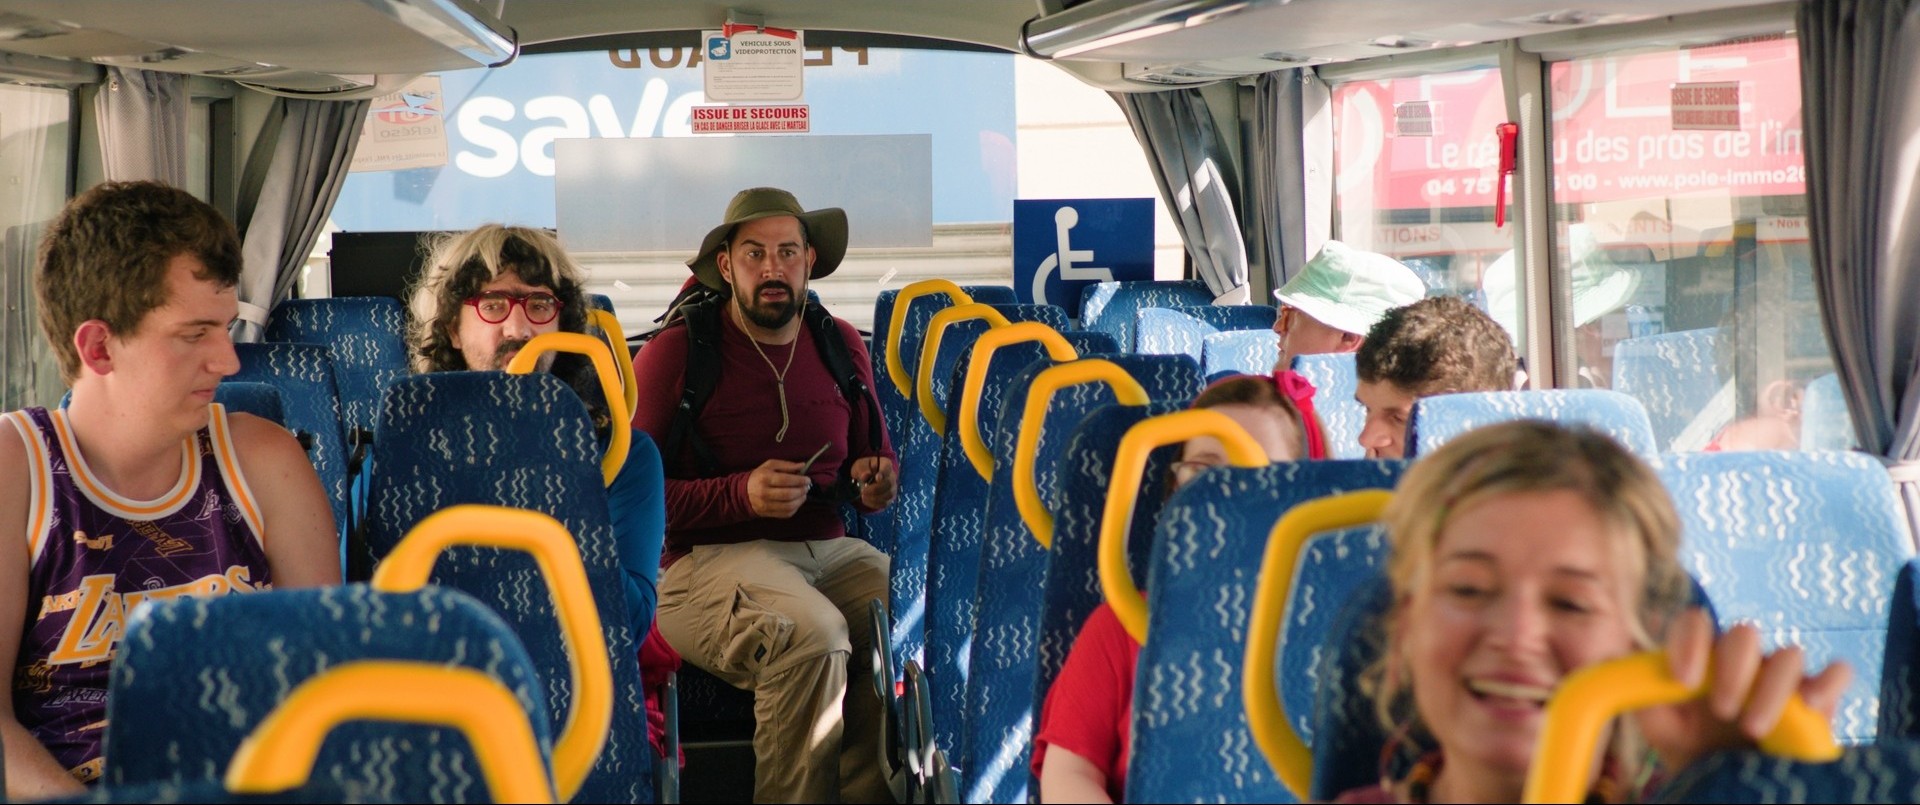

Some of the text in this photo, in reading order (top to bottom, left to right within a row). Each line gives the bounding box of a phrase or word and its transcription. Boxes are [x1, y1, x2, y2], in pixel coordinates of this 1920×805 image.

[694, 108, 807, 119] ISSUE DE SECOURS
[716, 122, 733, 130] DANGER
[749, 122, 755, 130] LA
[756, 121, 769, 130] GLACE
[787, 121, 807, 130] MARTEAU
[1425, 135, 1459, 169] Le
[1576, 129, 1630, 163] des
[1638, 132, 1705, 168] pros
[1713, 124, 1750, 158] de
[1427, 178, 1456, 195] 04
[1462, 177, 1491, 194] 75
[1568, 173, 1597, 190] 00
[46, 565, 250, 665] LARS
